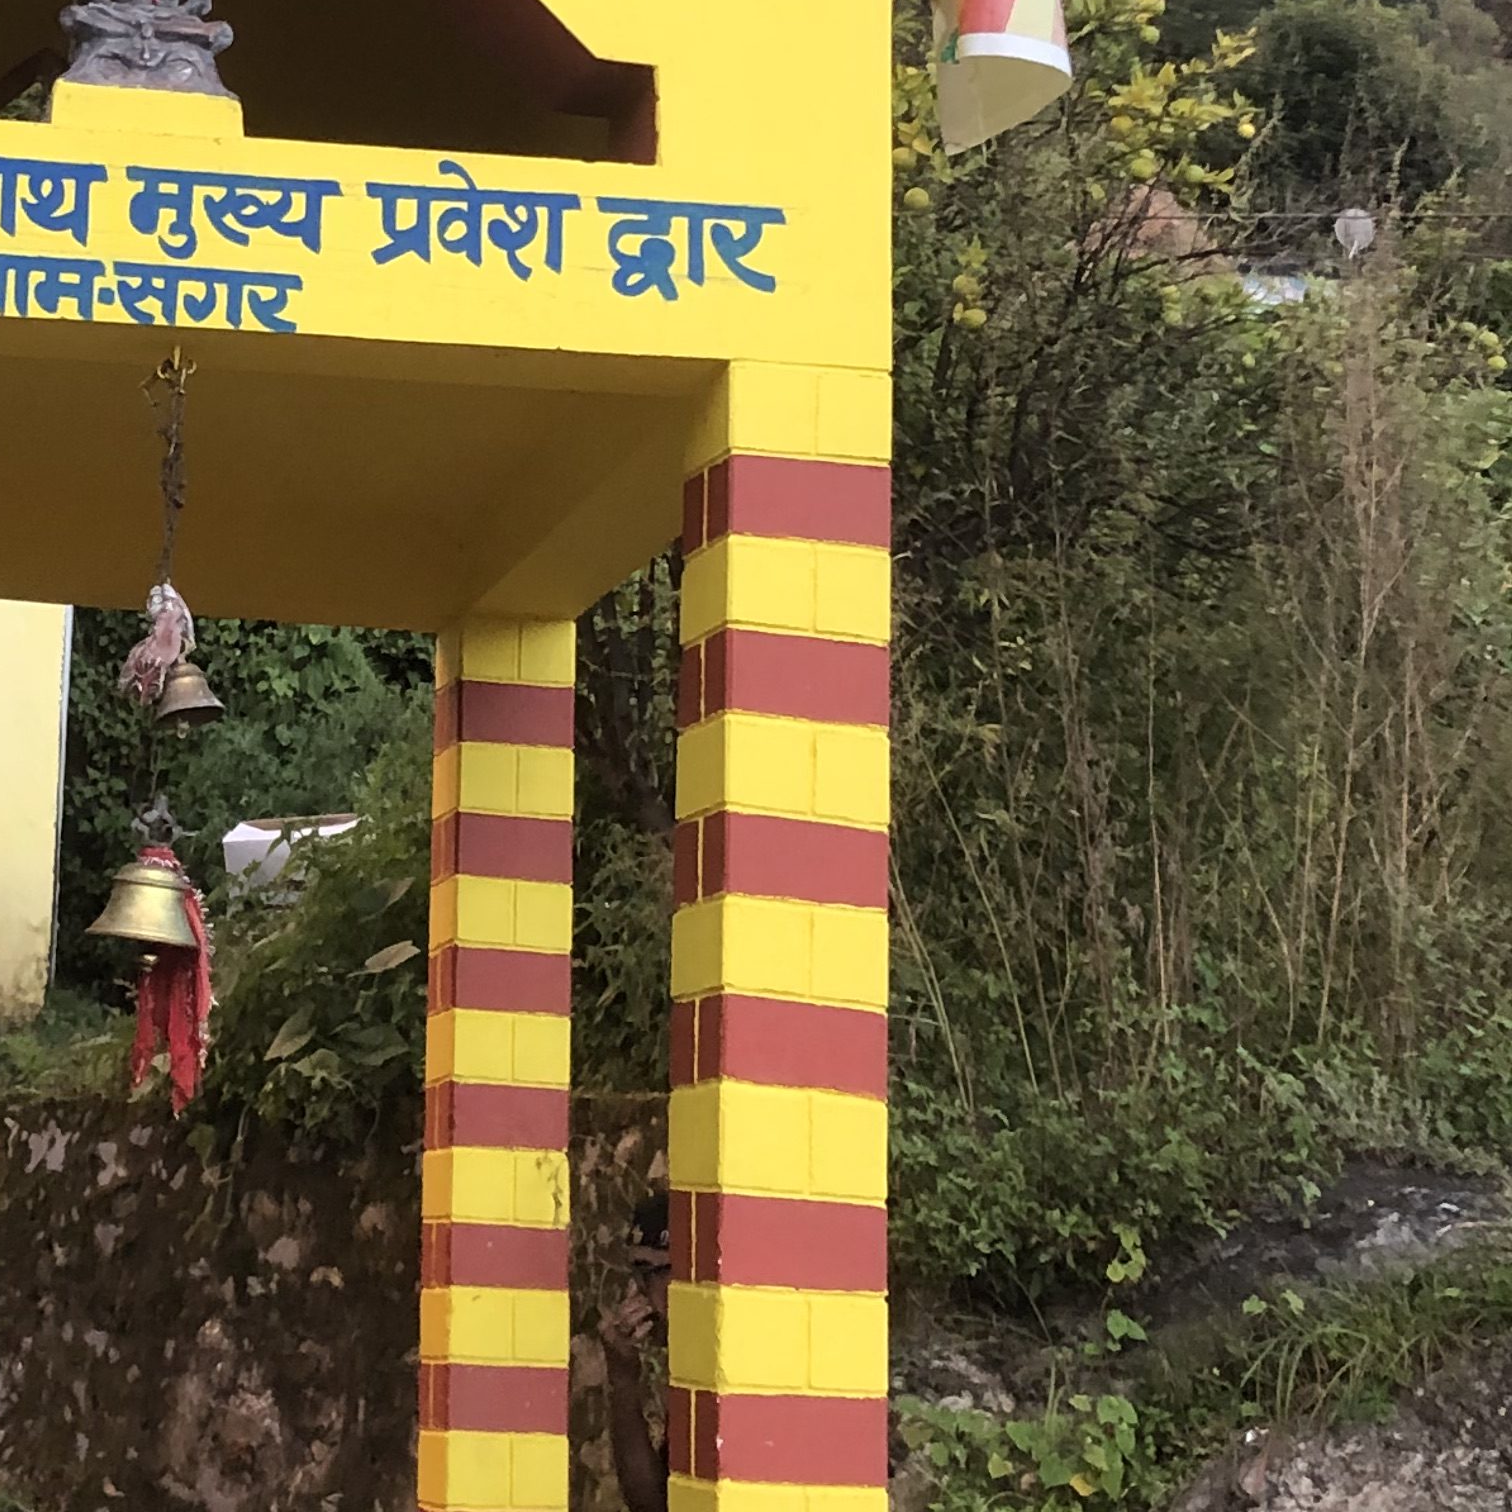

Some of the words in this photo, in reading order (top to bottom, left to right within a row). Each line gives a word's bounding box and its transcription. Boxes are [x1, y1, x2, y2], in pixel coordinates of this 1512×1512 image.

[128, 165, 341, 259] मुख्य
[366, 160, 581, 279] प्रवेश
[597, 196, 786, 301] द्वार
